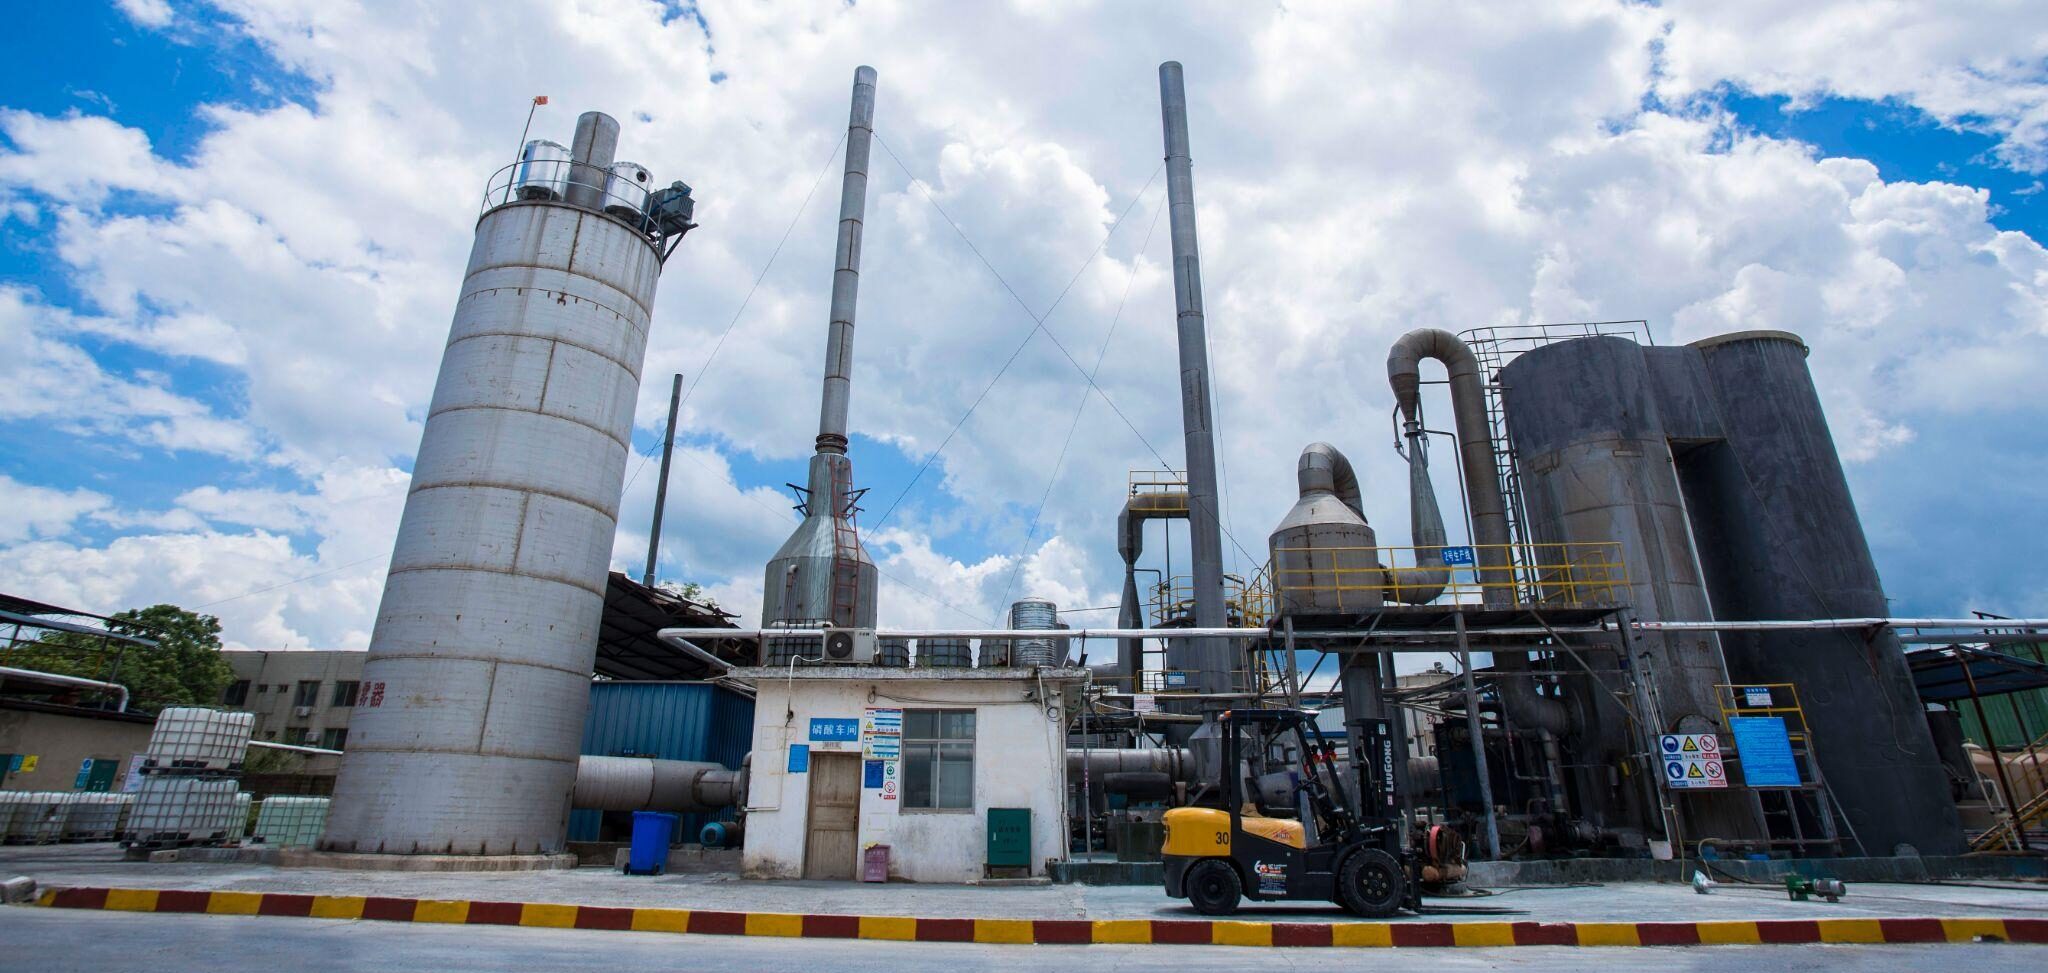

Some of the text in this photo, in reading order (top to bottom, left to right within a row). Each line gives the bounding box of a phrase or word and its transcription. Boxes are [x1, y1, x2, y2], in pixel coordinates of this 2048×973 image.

[1444, 549, 1472, 561] 2号生产线
[812, 724, 857, 735] 磷酸车间
[1215, 831, 1230, 845] 30
